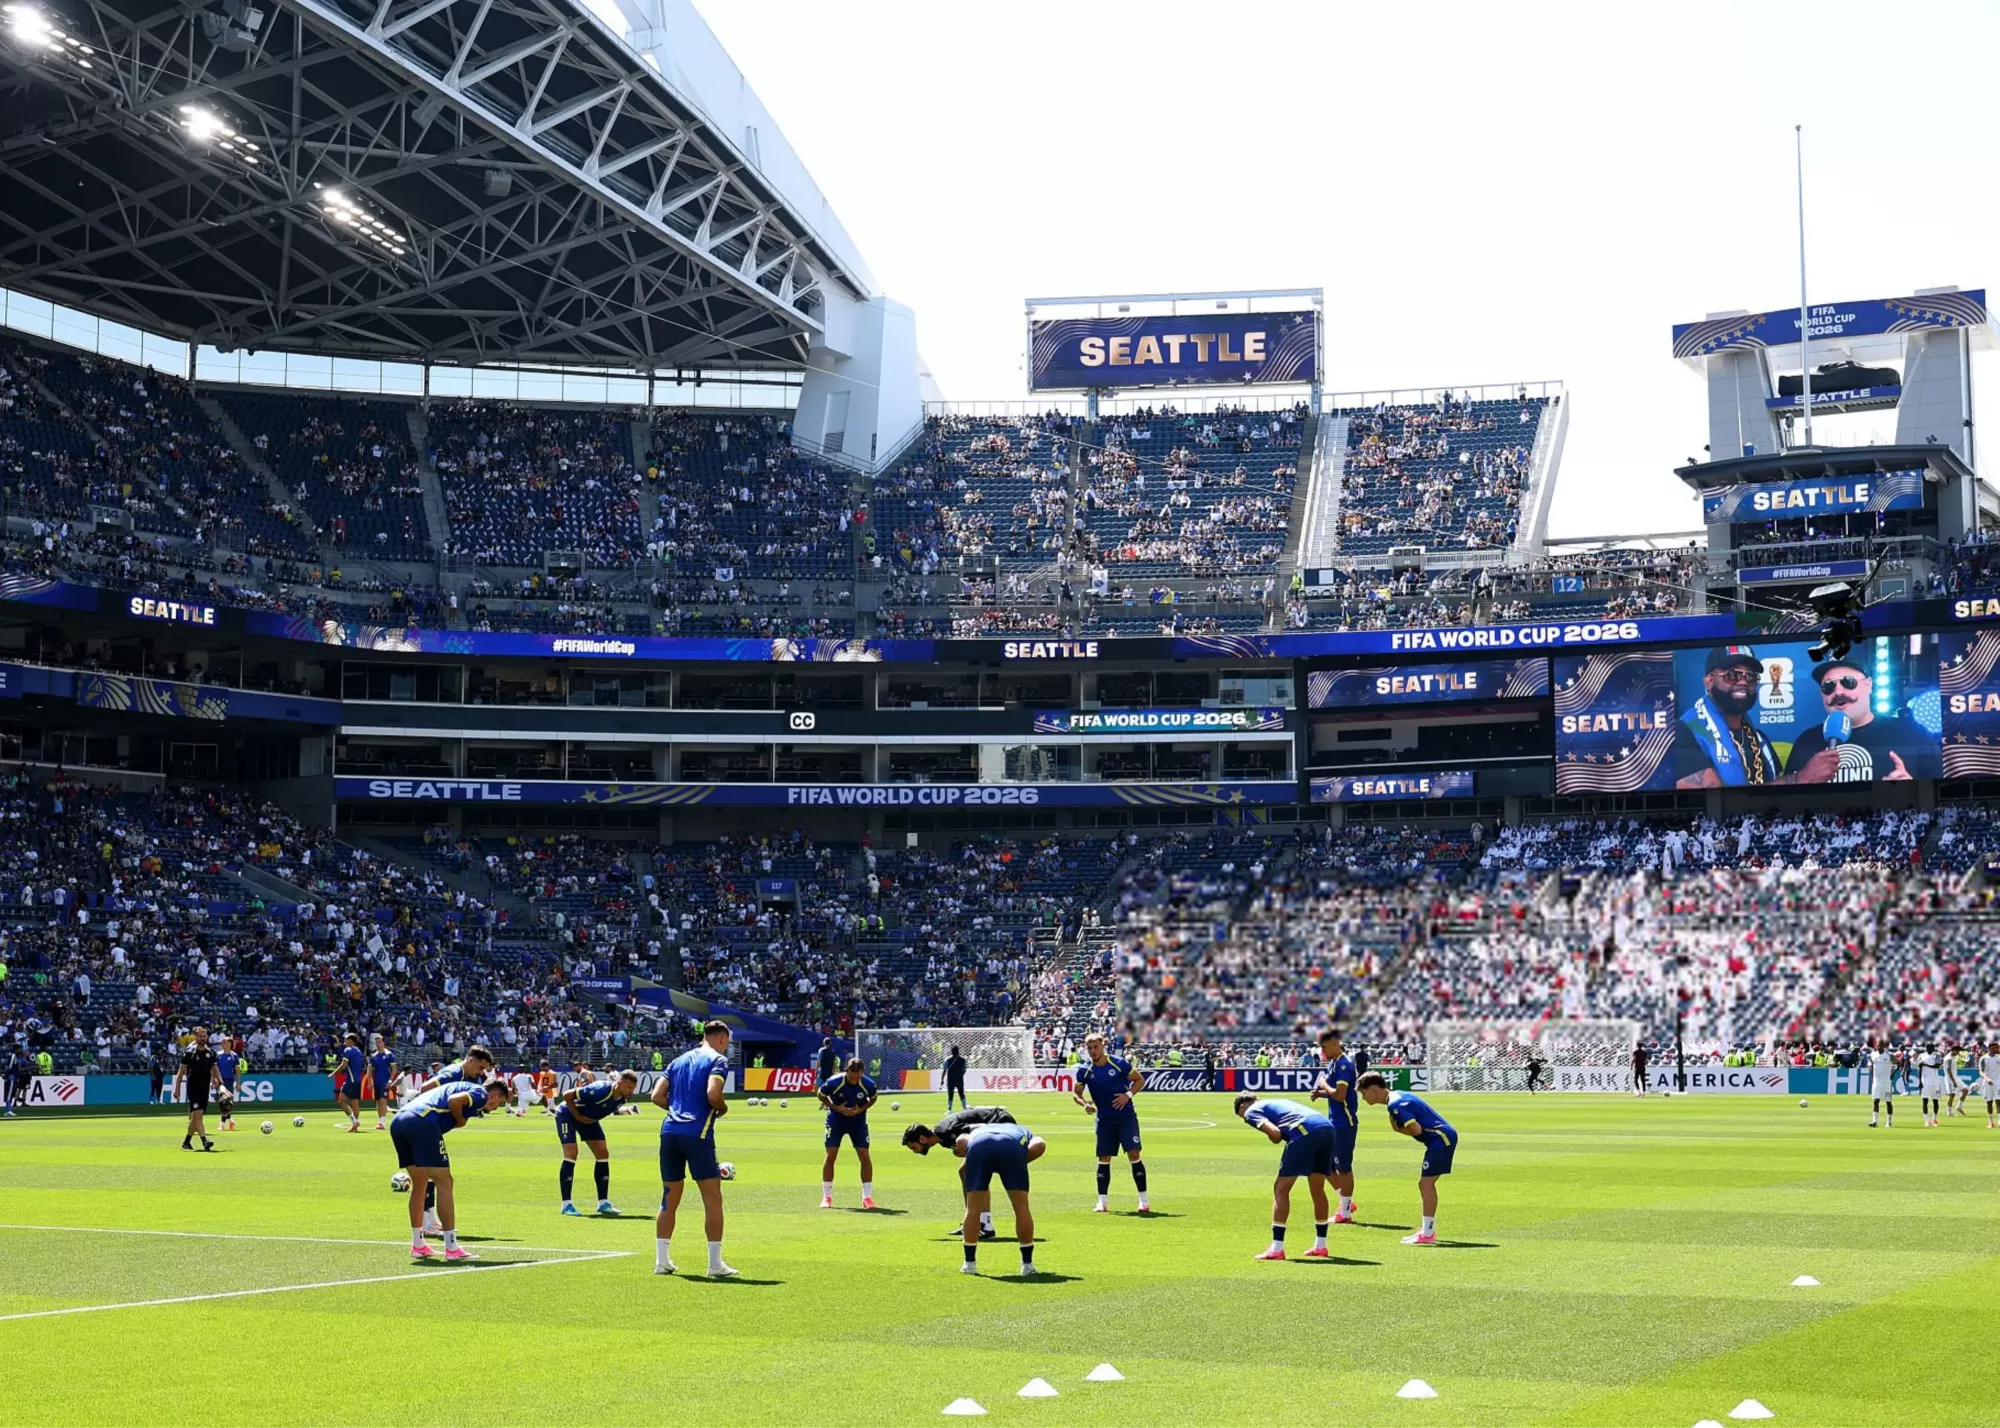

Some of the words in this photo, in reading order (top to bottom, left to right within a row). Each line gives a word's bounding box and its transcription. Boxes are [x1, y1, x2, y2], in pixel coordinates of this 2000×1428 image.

[1812, 306, 1836, 316] FIFA
[1834, 313, 1856, 324] CUP
[1807, 324, 1843, 336] 2026
[1079, 332, 1266, 367] SEATTLE
[1753, 483, 1869, 511] SEATTLE
[1773, 567, 1831, 578] #FIFAWorldCup
[1558, 578, 1577, 592] 12
[131, 597, 214, 625] SEATTLE
[1391, 632, 1437, 649] FIFA
[1439, 628, 1515, 647] WORLD
[1518, 626, 1561, 645] CUP
[1563, 622, 1640, 642] 2026
[552, 639, 636, 656] #FIFAWorldCup
[1004, 642, 1099, 658] SEATTLE
[1376, 671, 1477, 694] SEATTLE
[792, 714, 813, 728] CC
[1070, 715, 1101, 727] FIFA
[1103, 714, 1158, 726] WORLD
[1160, 713, 1191, 726] CUP
[1192, 712, 1246, 725] 2026
[1562, 711, 1667, 733] SEATTLE
[1759, 715, 1795, 723] 2026
[368, 781, 522, 799] SEATTLE
[1352, 779, 1430, 795] SEATTLE
[787, 788, 834, 805] FIFA
[836, 788, 914, 805] WORLD
[917, 788, 961, 805] CUP
[963, 788, 1040, 805] 2026
[603, 981, 623, 989] 2026
[773, 1068, 813, 1092] Lay's
[1561, 1073, 1618, 1089] BANK
[1657, 1073, 1756, 1088] AMERICA
